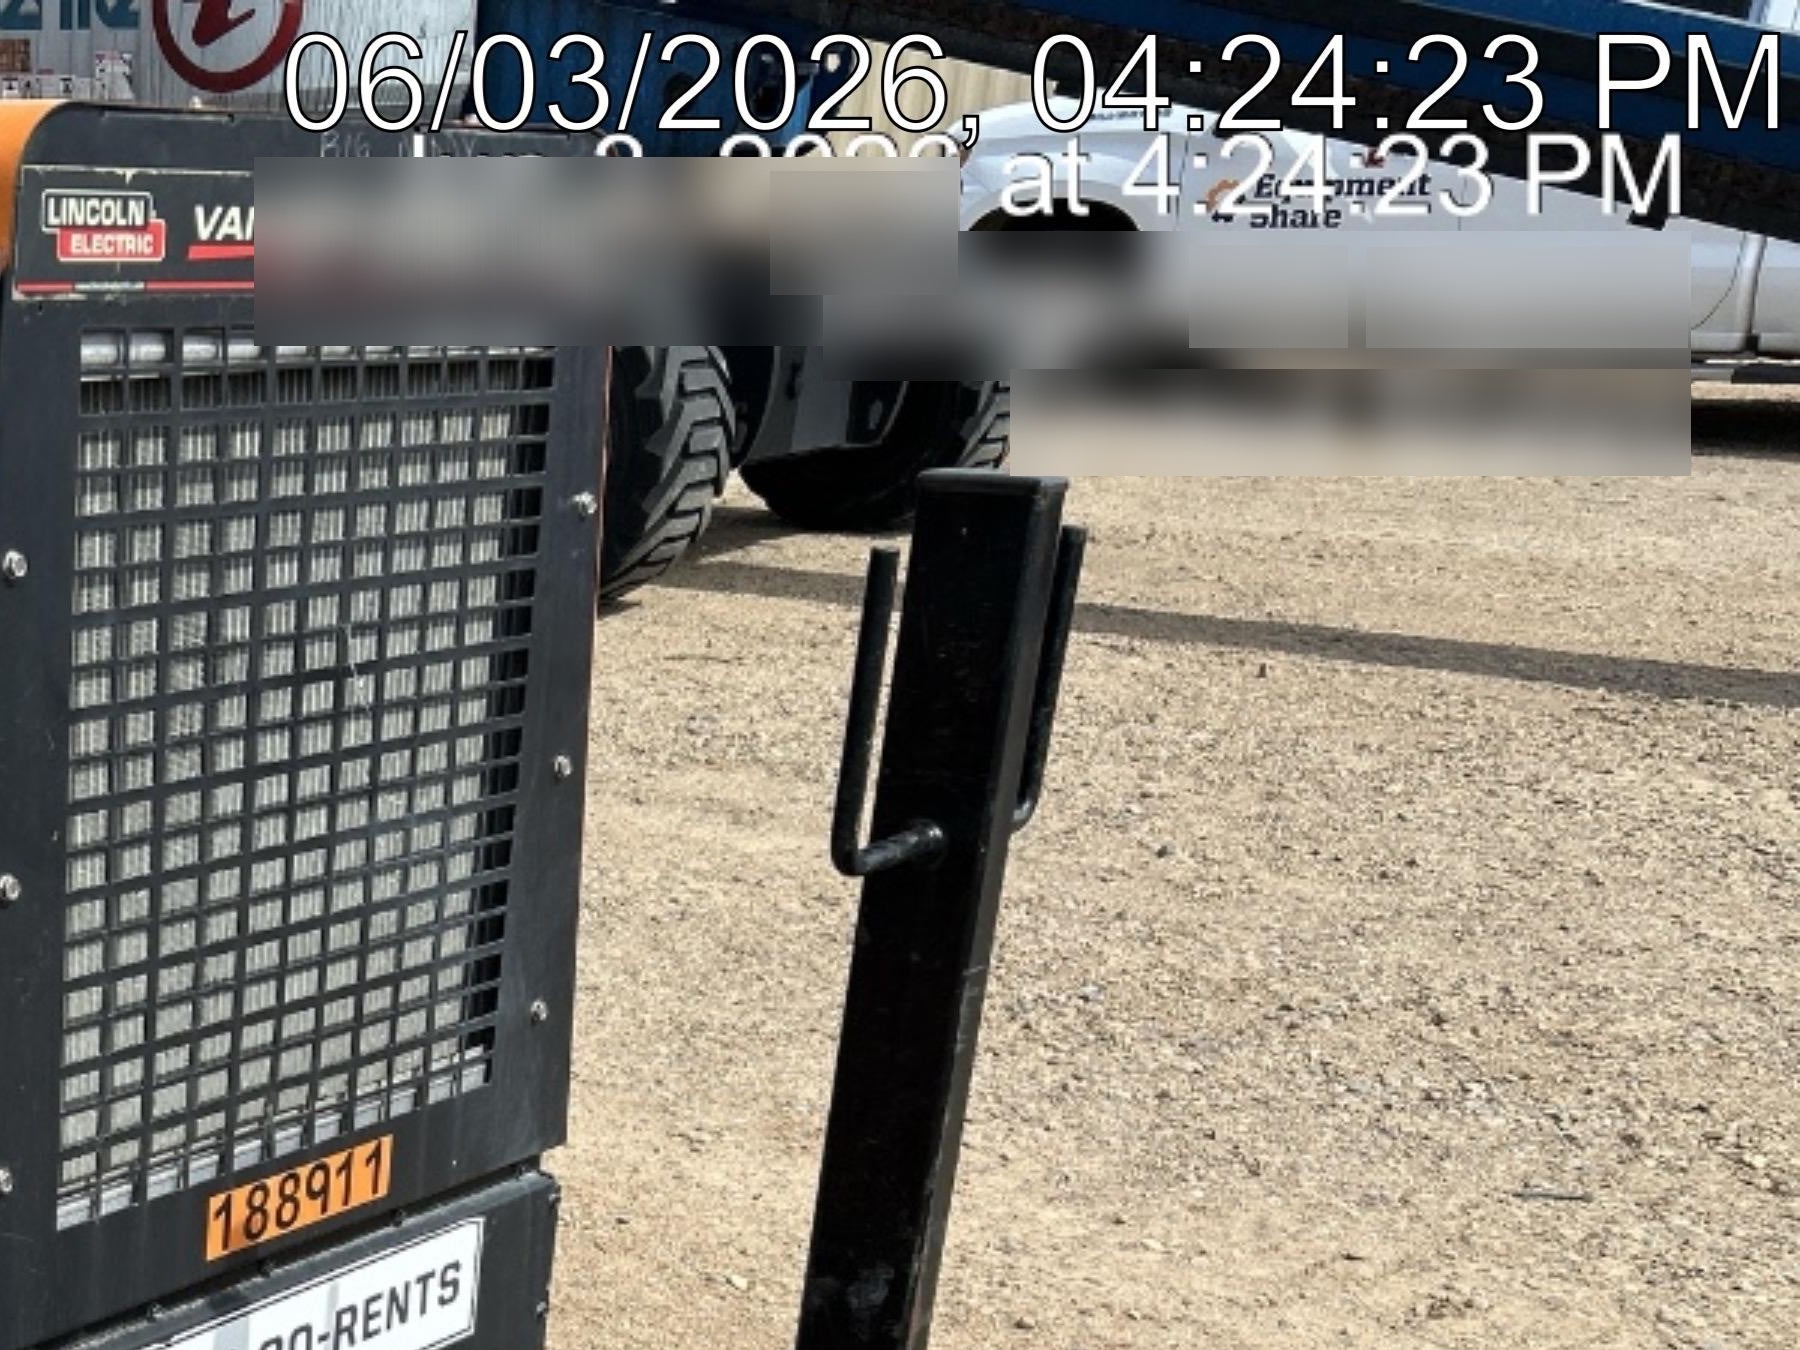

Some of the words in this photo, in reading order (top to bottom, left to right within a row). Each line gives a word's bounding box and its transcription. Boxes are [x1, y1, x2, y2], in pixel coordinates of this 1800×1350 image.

[46, 196, 146, 227] LINCOLN
[70, 231, 154, 256] ELECTRIC
[213, 1149, 385, 1252] 188911
